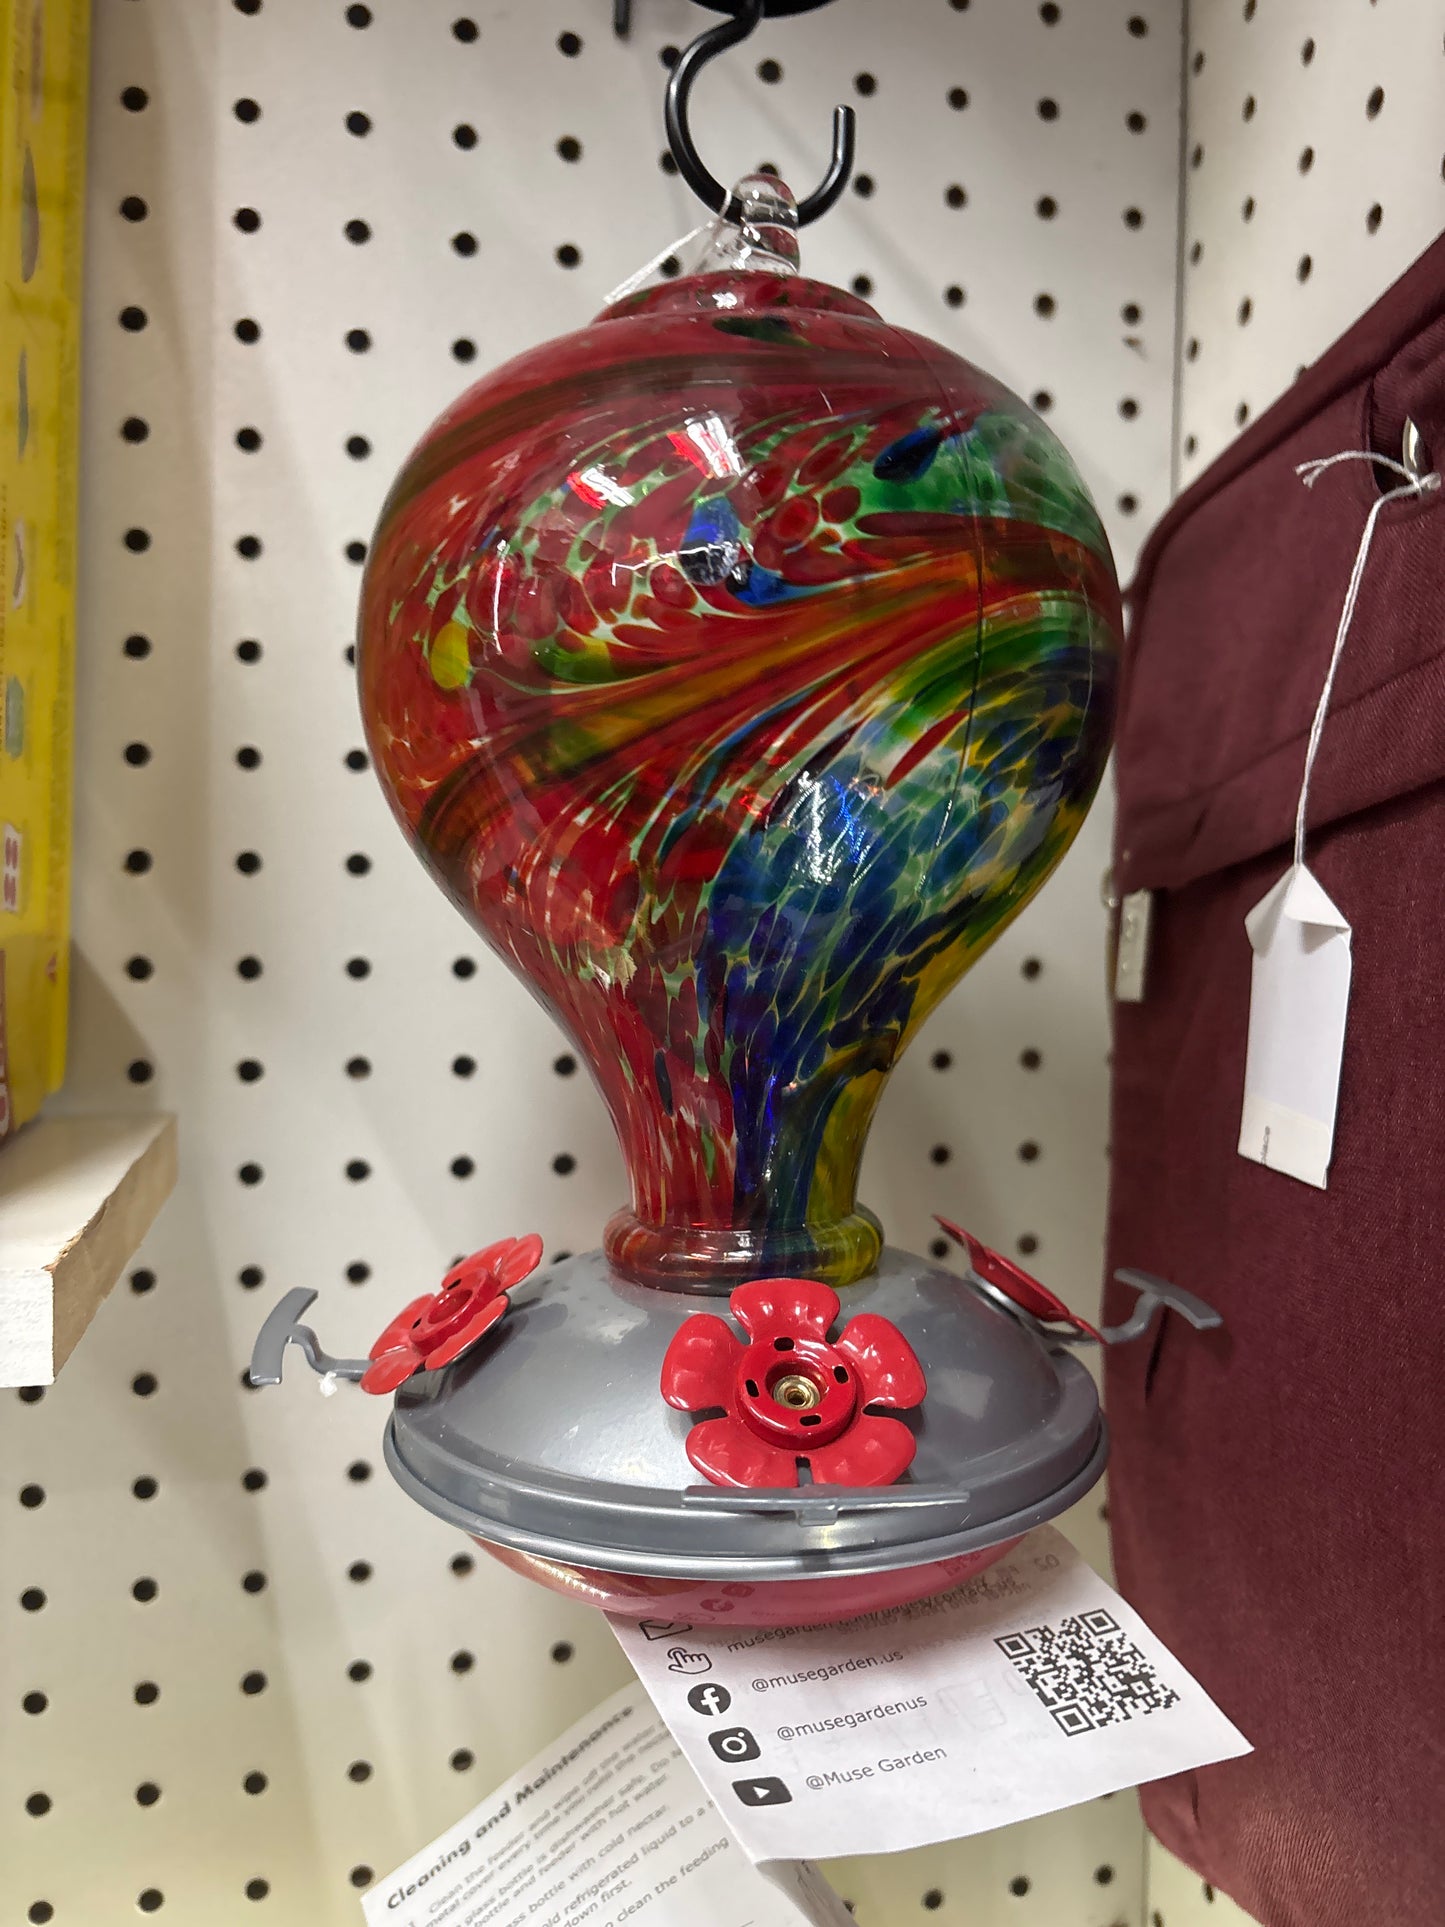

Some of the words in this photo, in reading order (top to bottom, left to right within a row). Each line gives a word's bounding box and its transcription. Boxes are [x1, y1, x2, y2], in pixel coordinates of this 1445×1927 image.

[751, 1650, 904, 1692] @musegarden.us
[777, 1695, 928, 1741] @musegardenus
[805, 1765, 875, 1790] @Muse
[878, 1747, 948, 1772] Garden
[387, 1838, 471, 1909] Cleaning
[475, 1801, 511, 1838] and
[515, 1705, 633, 1804] Maintenance
[528, 1881, 566, 1913] bottle
[568, 1857, 596, 1881] with
[598, 1834, 625, 1858] cold
[564, 1853, 640, 1915] refrigerated
[640, 1826, 677, 1856] liquid
[679, 1815, 695, 1828] to
[617, 1893, 653, 1922] clean
[654, 1875, 678, 1894] the
[679, 1836, 730, 1877] feeding
[565, 1902, 599, 1927] down
[600, 1880, 632, 1903] first.
